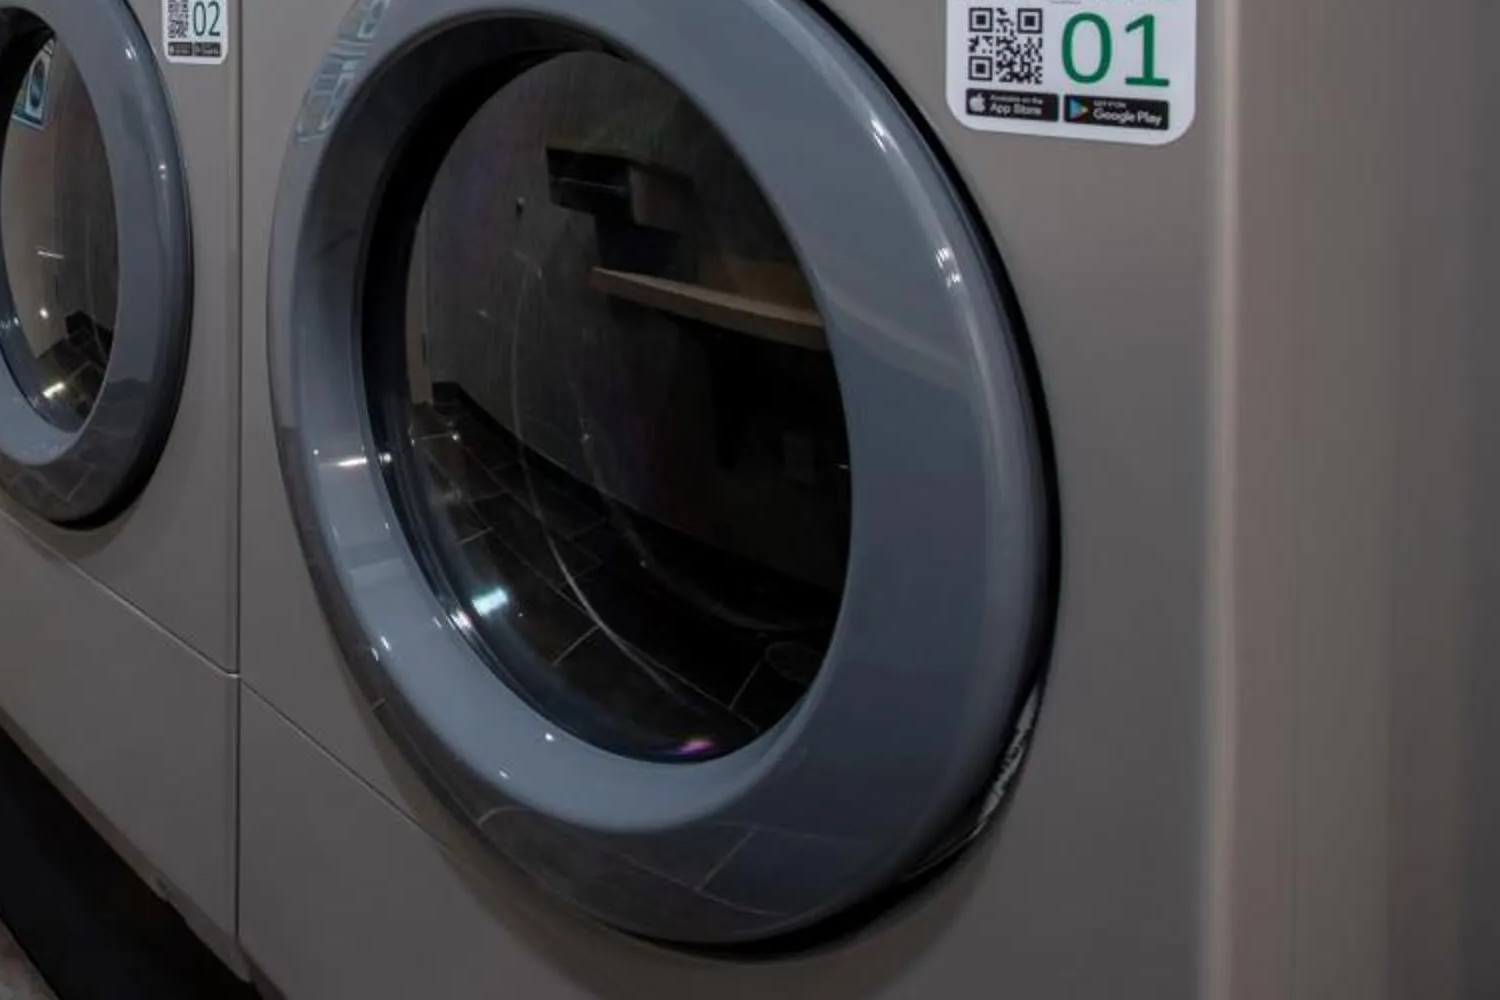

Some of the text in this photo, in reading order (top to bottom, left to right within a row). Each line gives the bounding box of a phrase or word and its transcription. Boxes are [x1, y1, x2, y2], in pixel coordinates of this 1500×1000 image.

[193, 0, 221, 37] 02
[1061, 11, 1170, 88] 01
[990, 102, 1011, 115] App
[1092, 107, 1163, 126] Google Play
